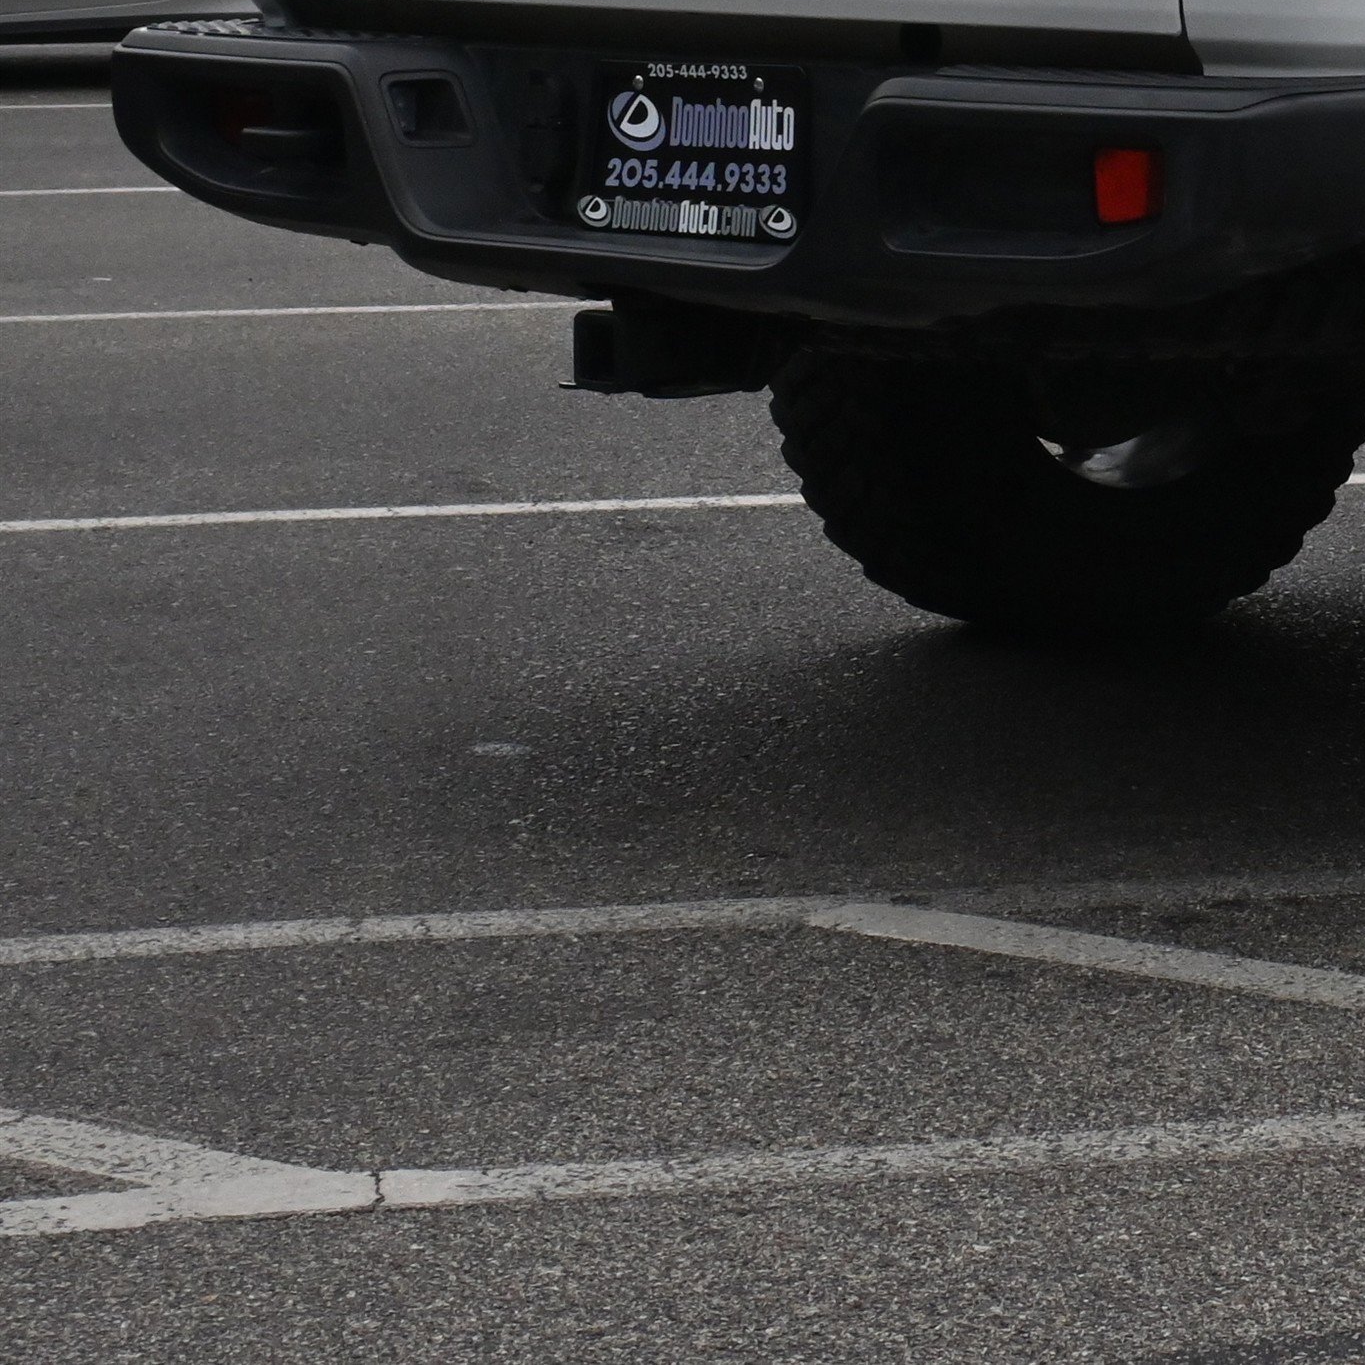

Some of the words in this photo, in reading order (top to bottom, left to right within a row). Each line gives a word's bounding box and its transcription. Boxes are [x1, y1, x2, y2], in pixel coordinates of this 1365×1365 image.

[647, 63, 748, 80] 205-444-9333
[669, 96, 795, 151] DonohooAuto
[605, 158, 787, 195] 205.444.9333
[611, 196, 757, 237] DonohooAuto.com
